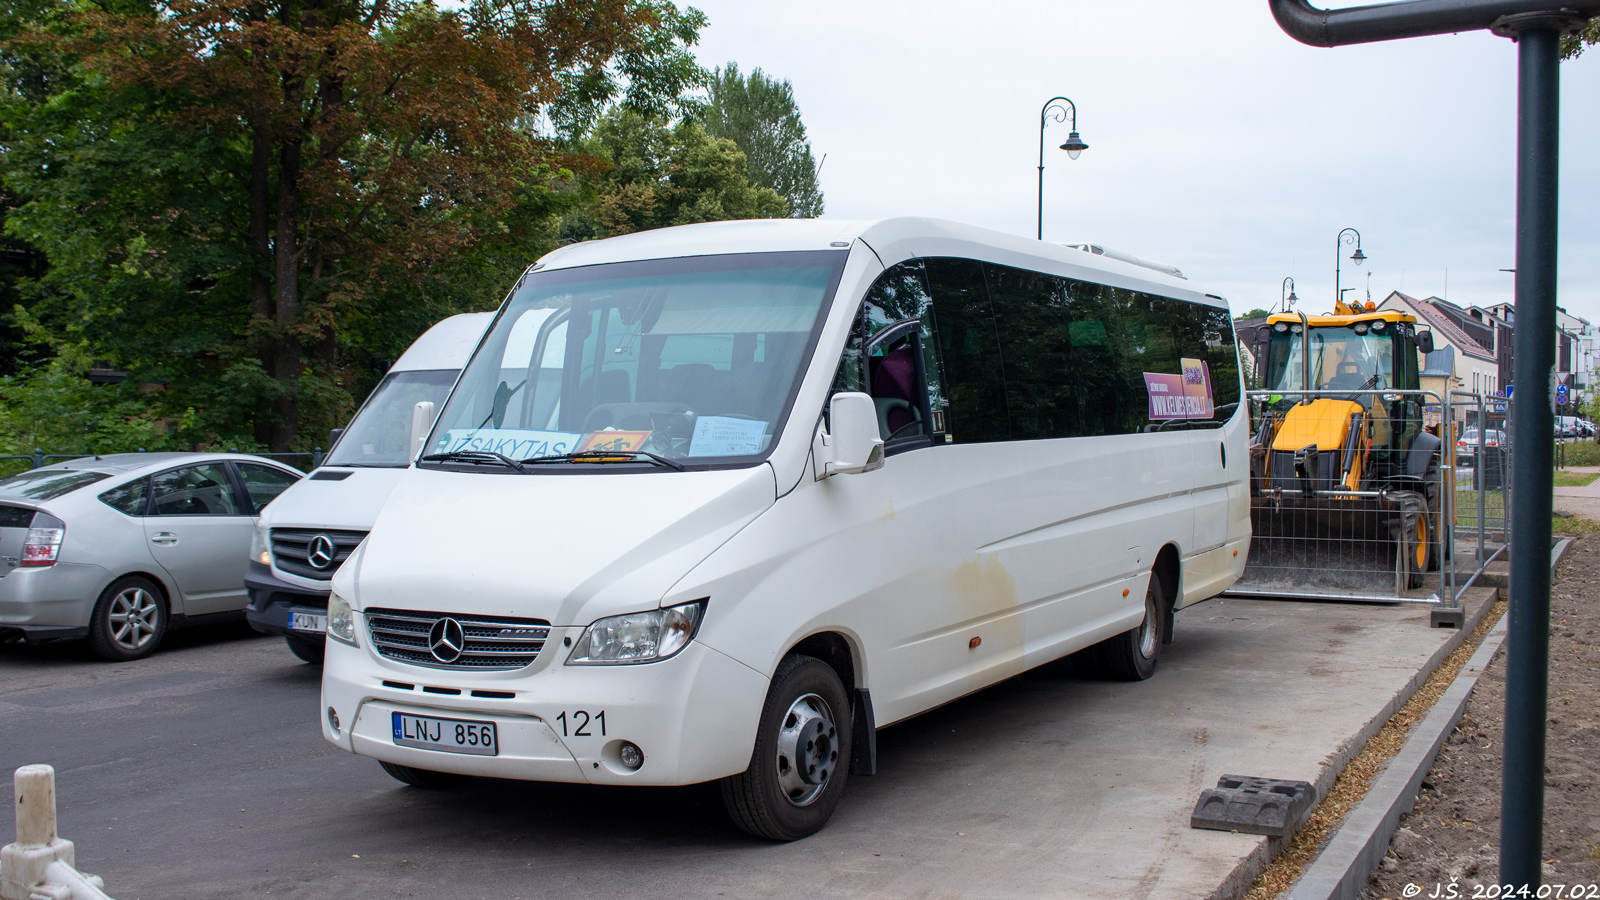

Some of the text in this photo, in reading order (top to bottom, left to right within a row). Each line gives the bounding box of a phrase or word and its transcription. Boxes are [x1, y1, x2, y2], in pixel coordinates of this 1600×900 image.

[294, 614, 318, 629] KUN
[403, 717, 493, 747] LNJ 856
[556, 710, 607, 737] 121
